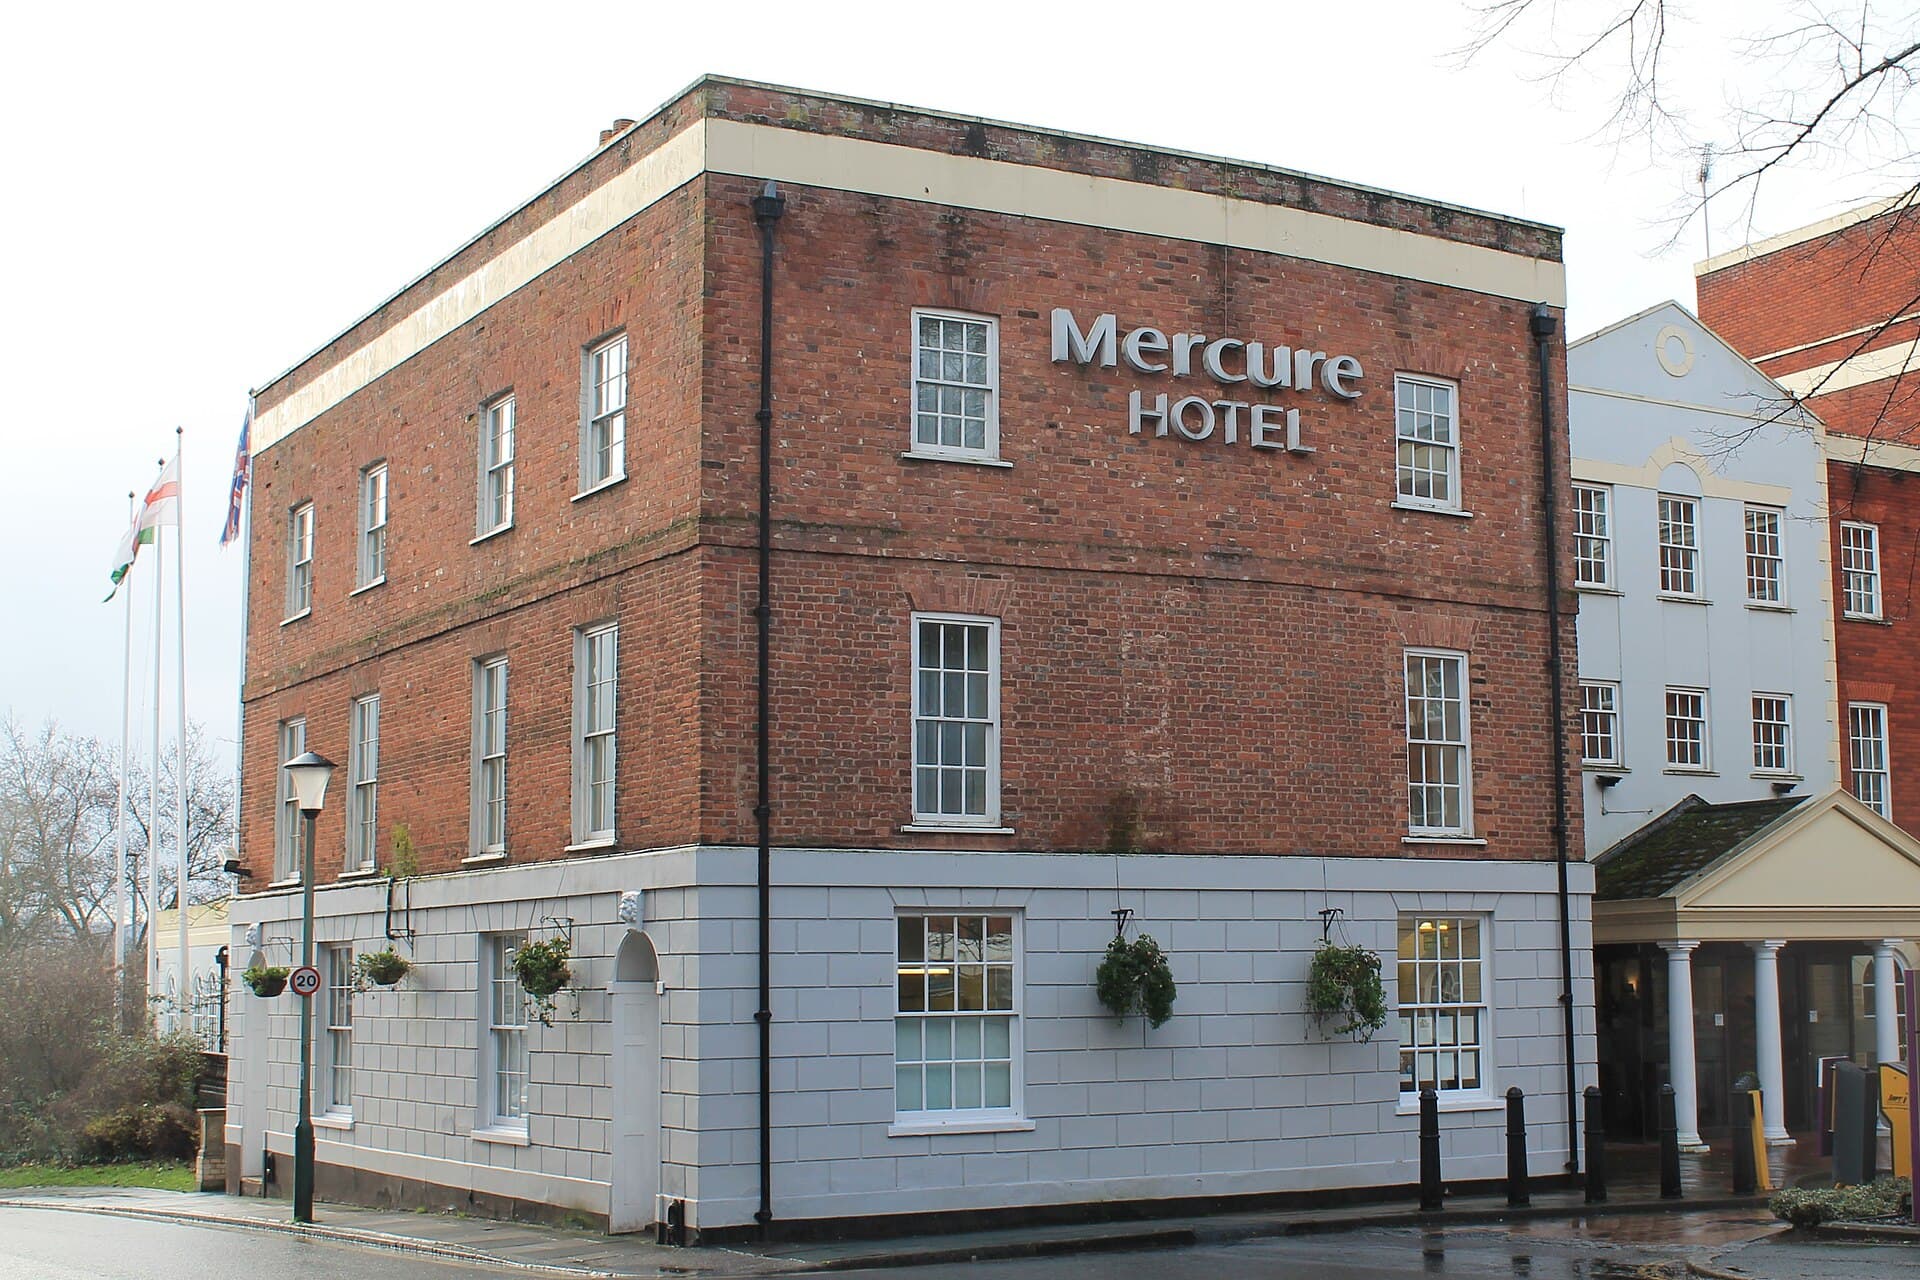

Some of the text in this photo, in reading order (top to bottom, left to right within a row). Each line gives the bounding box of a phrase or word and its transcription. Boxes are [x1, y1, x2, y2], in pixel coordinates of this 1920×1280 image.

[1050, 307, 1365, 400] Mercure
[1128, 390, 1317, 454] HOTEL
[296, 975, 317, 987] 20
